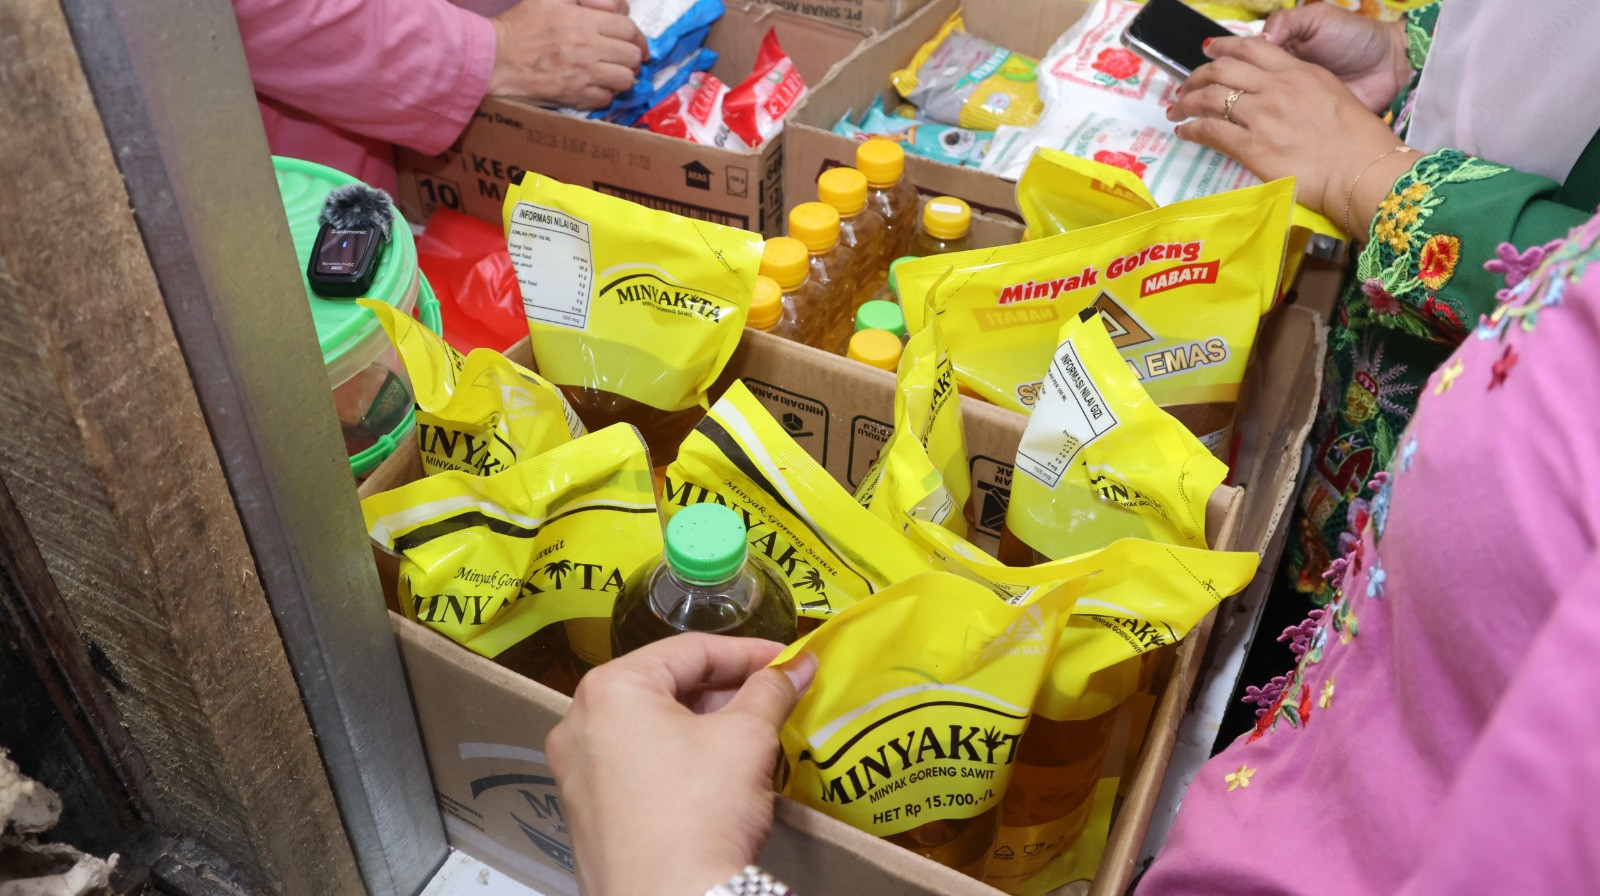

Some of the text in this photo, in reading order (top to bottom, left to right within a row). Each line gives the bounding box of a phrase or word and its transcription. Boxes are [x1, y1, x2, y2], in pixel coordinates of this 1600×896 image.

[803, 5, 840, 17] SINAR
[419, 177, 460, 210] 10
[519, 208, 580, 233] INFORMASI NILAI GIZI
[998, 241, 1202, 304] Minyak Goreng
[1144, 266, 1209, 294] NABATI
[1148, 338, 1227, 378] EMAS
[1060, 353, 1103, 420] INFORMASI NILAI GIZI
[781, 396, 823, 416] HINDARI
[857, 428, 880, 441] DULU
[723, 478, 838, 577] Minyak Goreng Sawit
[534, 539, 566, 562] awit
[454, 566, 499, 588] Minyak
[1022, 644, 1048, 656] MAS
[869, 767, 995, 804] MINYAK GORENG SAWIT
[873, 807, 901, 824] HET
[905, 803, 921, 817] Rp
